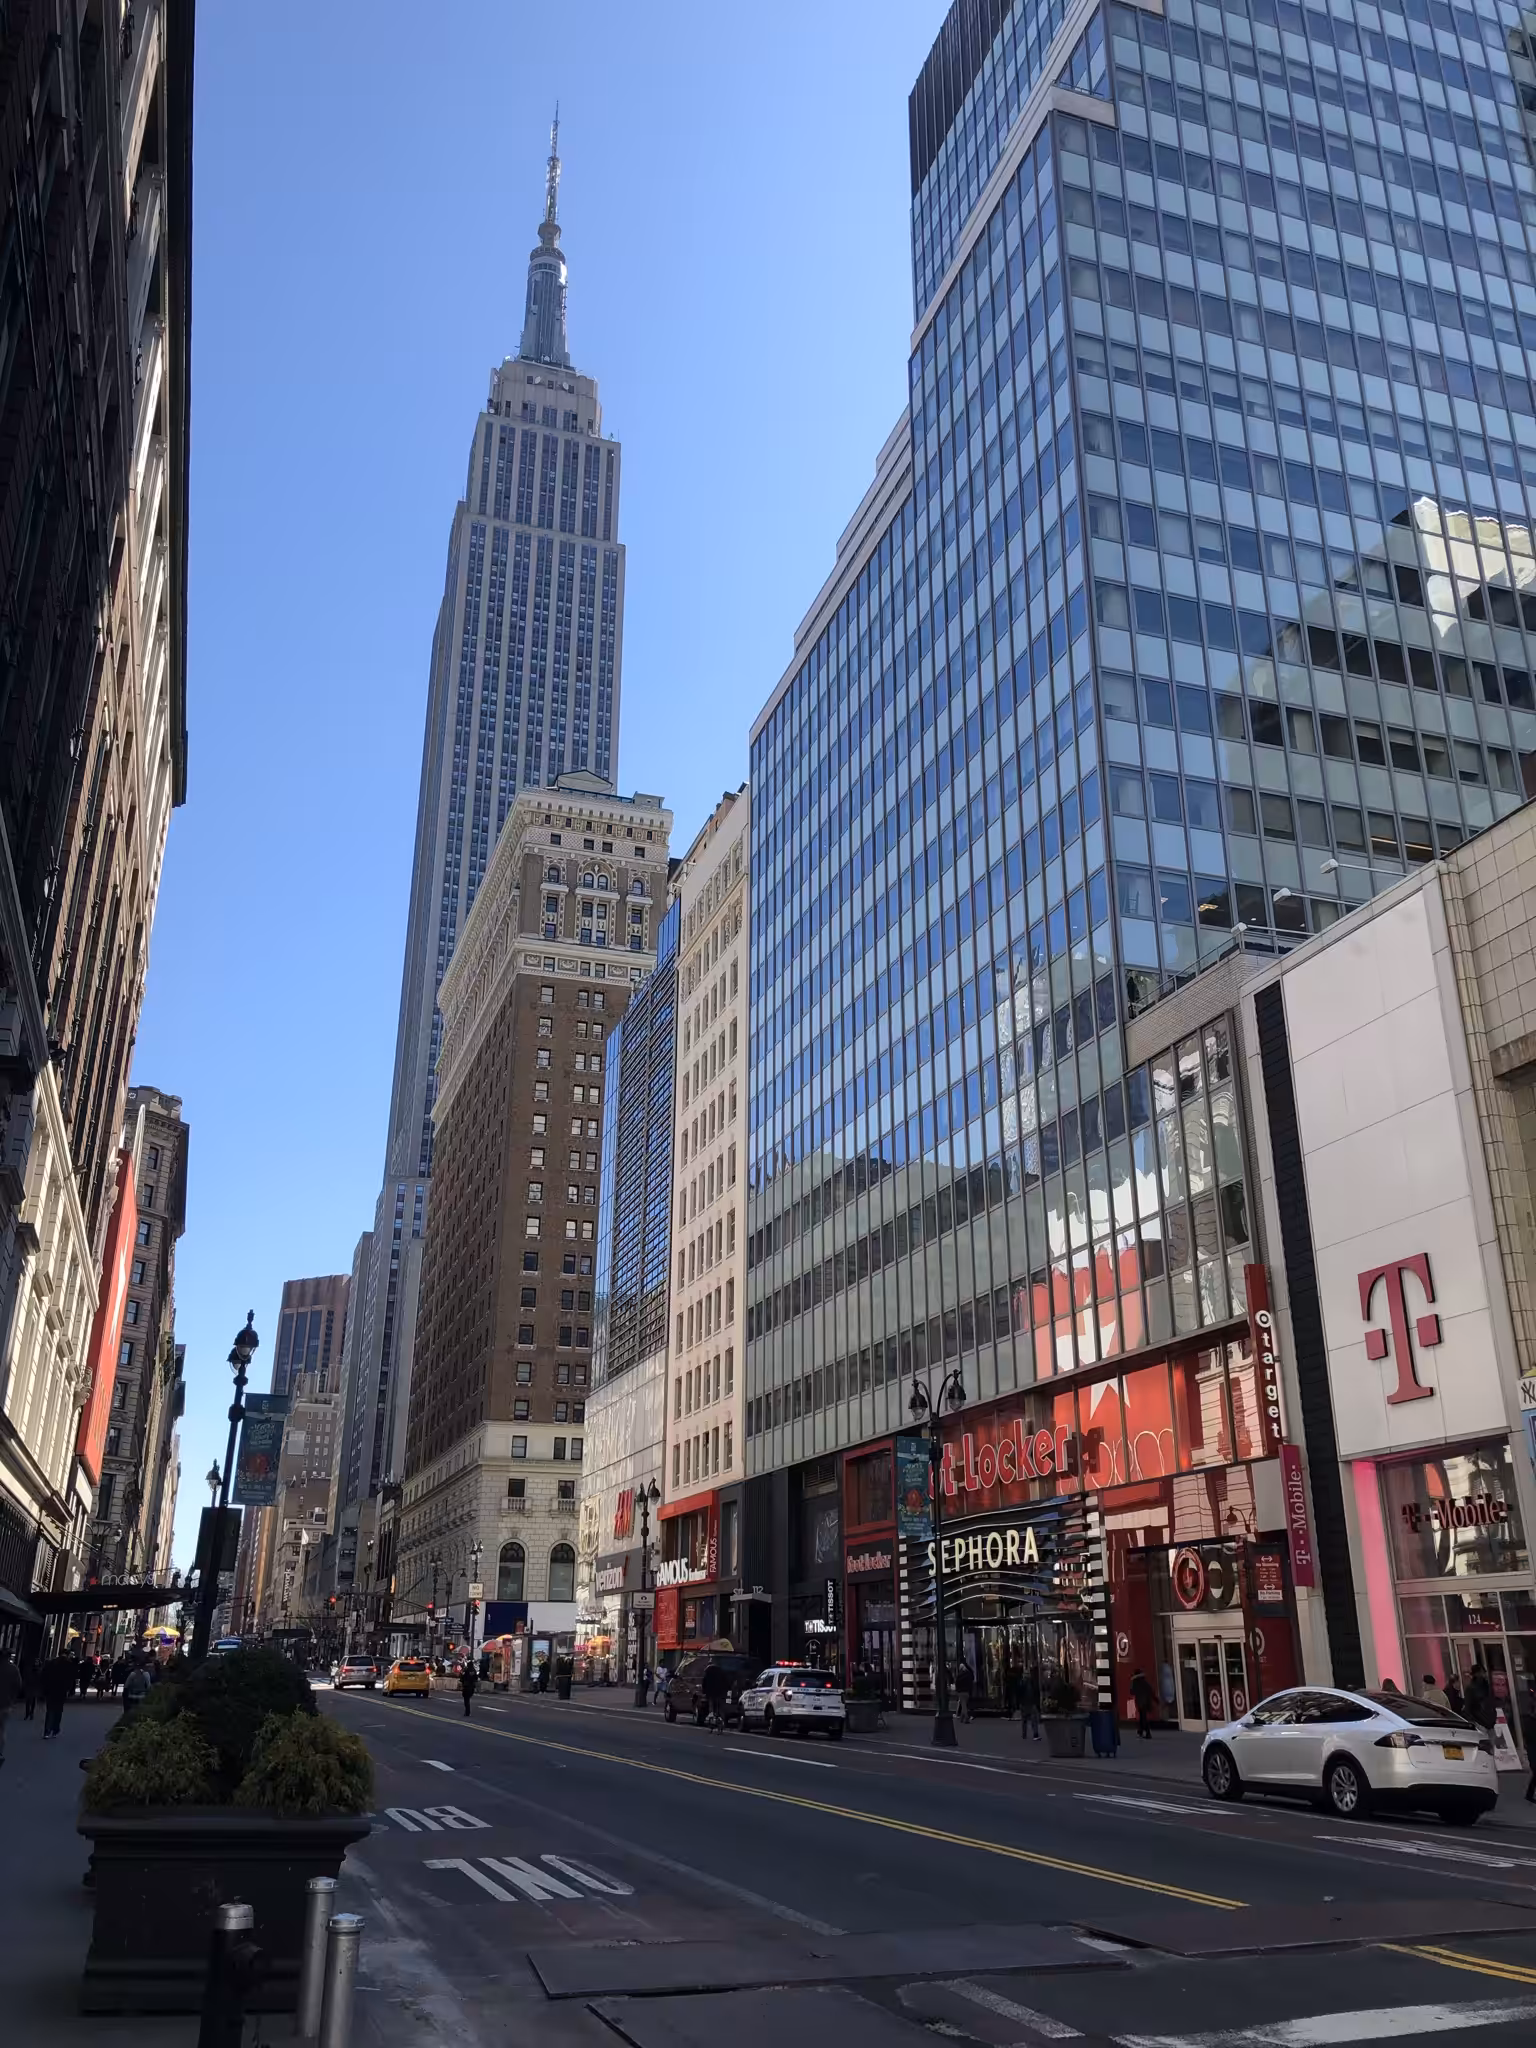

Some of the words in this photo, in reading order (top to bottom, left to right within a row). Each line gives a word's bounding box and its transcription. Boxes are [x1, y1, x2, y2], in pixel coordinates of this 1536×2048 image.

[1357, 1252, 1441, 1405] T
[1260, 1332, 1281, 1439] target
[962, 1419, 1072, 1492] Locker
[709, 1537, 718, 1573] FAMOUS
[927, 1526, 1040, 1577] SEPHORA
[595, 1562, 625, 1593] verizon
[656, 1557, 688, 1587] FAMOUS
[752, 1586, 764, 1594] 112
[1468, 1613, 1481, 1625] 124
